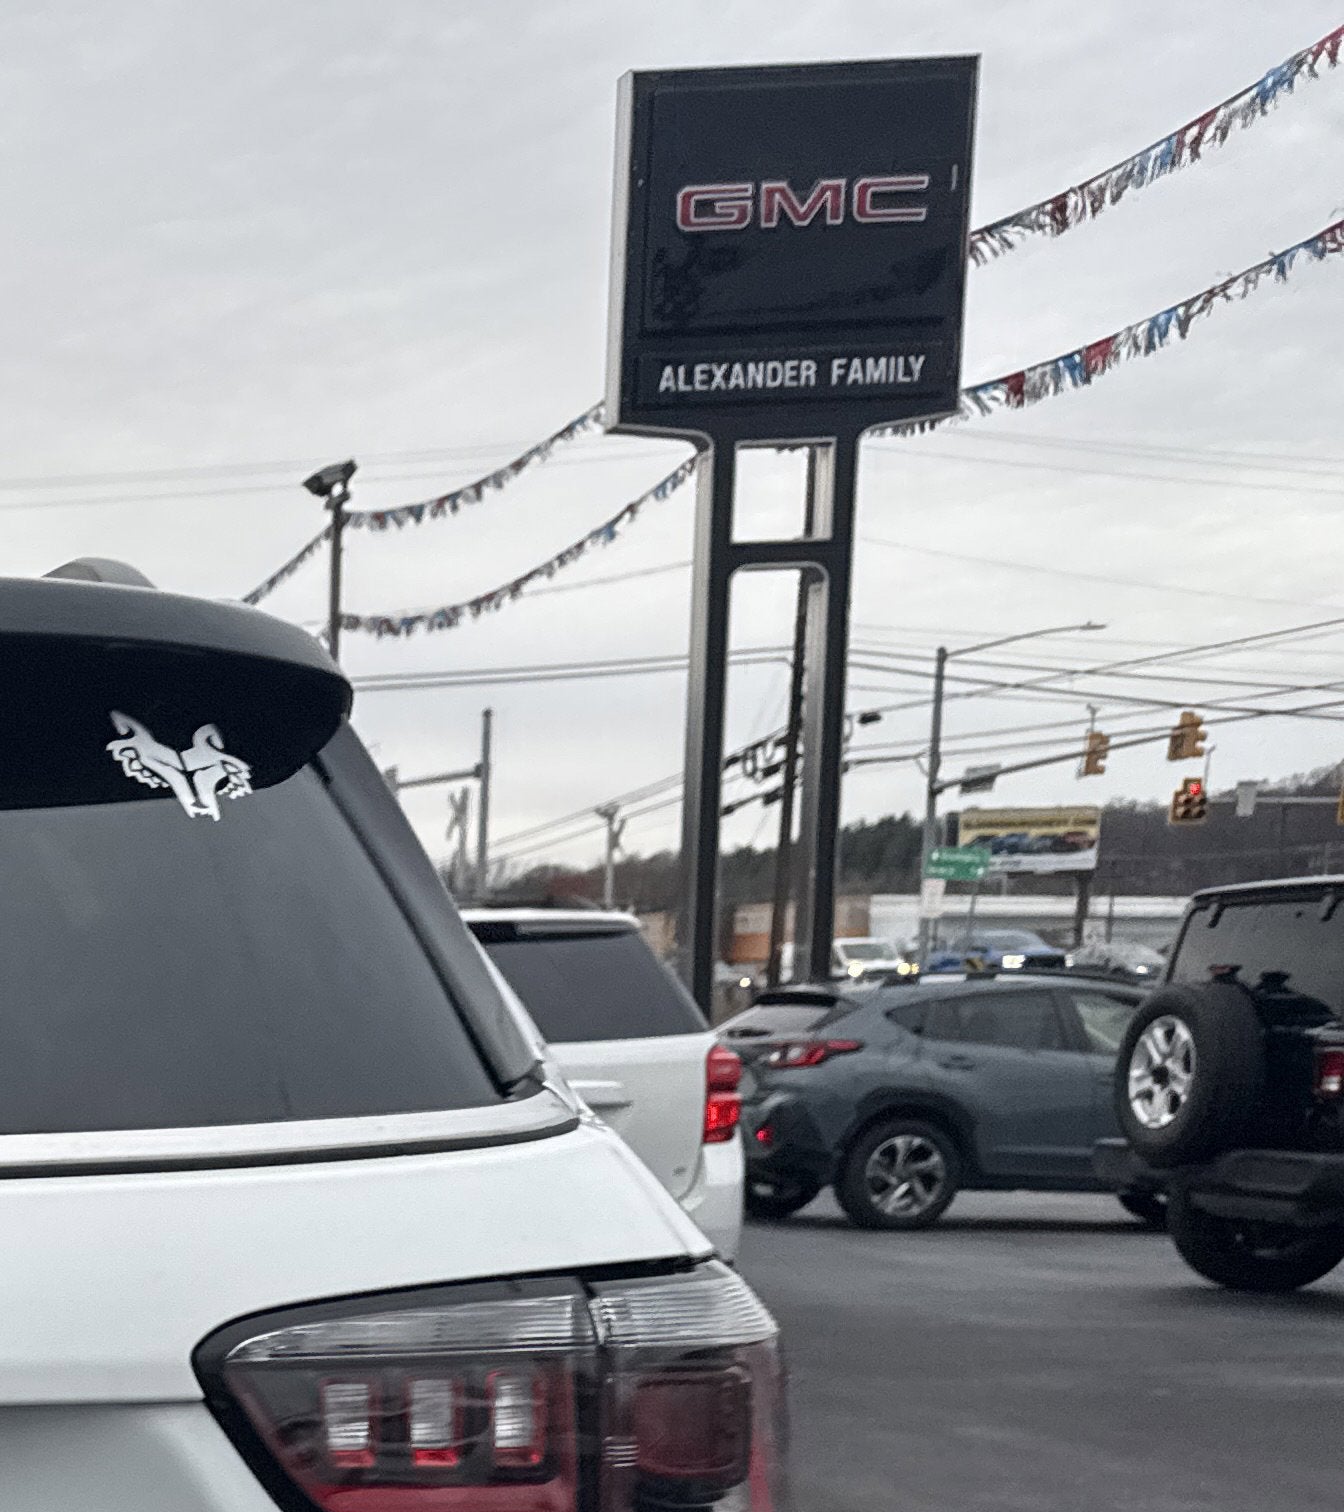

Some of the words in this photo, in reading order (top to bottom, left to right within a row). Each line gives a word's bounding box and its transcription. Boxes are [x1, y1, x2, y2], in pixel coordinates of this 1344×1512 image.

[677, 175, 929, 232] GMC
[659, 360, 817, 392] ALEXANDER
[831, 355, 926, 385] FAMILY
